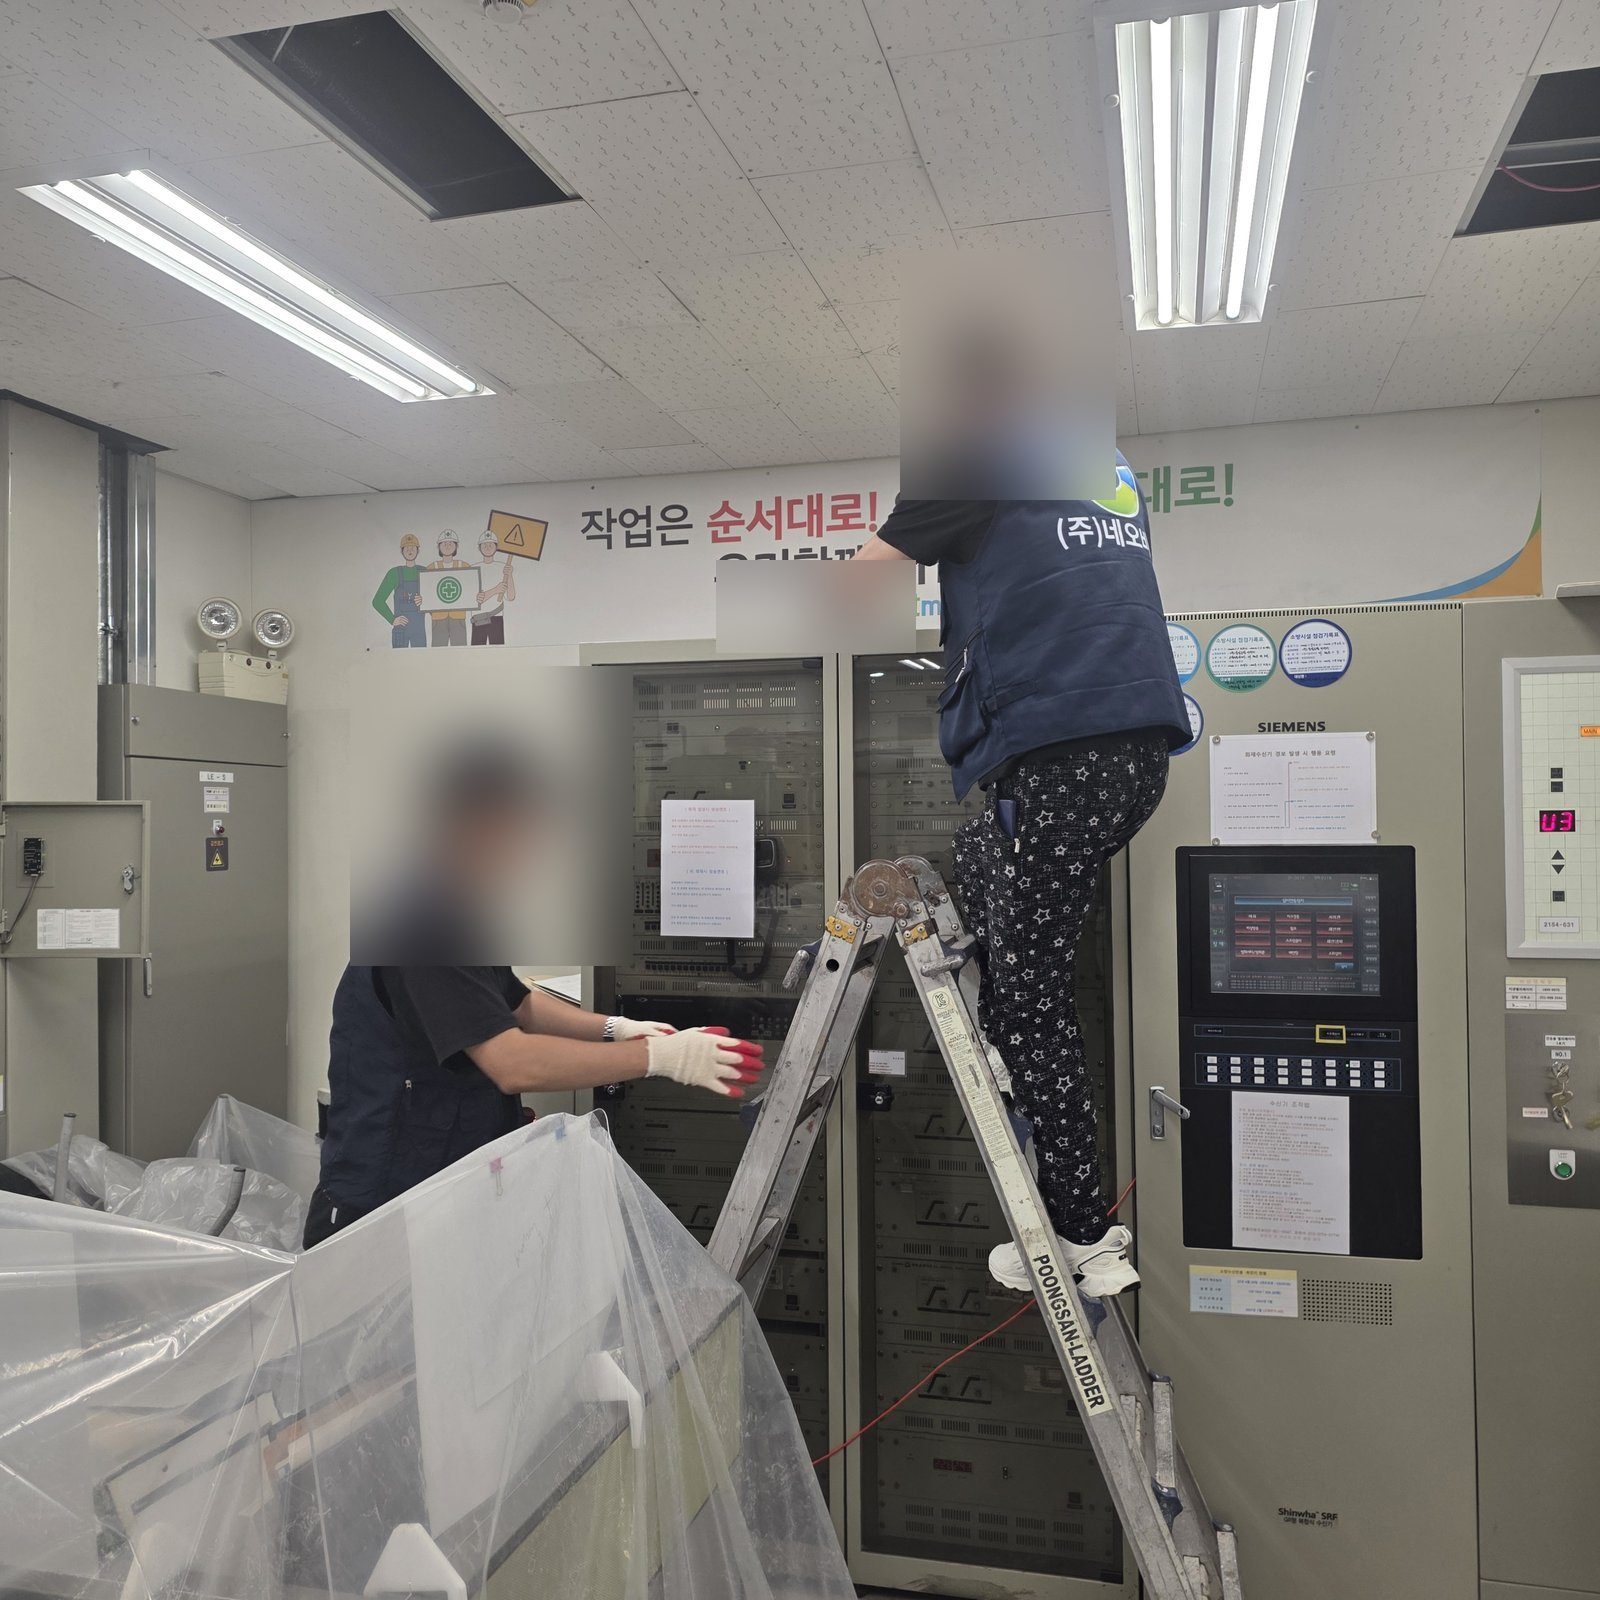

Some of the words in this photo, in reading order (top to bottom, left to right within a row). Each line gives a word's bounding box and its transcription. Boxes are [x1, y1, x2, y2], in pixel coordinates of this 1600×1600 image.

[580, 503, 694, 550] 작업은
[706, 491, 879, 544] 순서대로!
[1215, 636, 1237, 644] 소방시설
[1290, 632, 1312, 640] 소방시설
[1312, 631, 1340, 639] 점검기록표
[1257, 721, 1326, 733] SIEMENS
[1033, 1254, 1105, 1409] POONGSAN-LADDER
[1321, 1512, 1338, 1520] SRF
